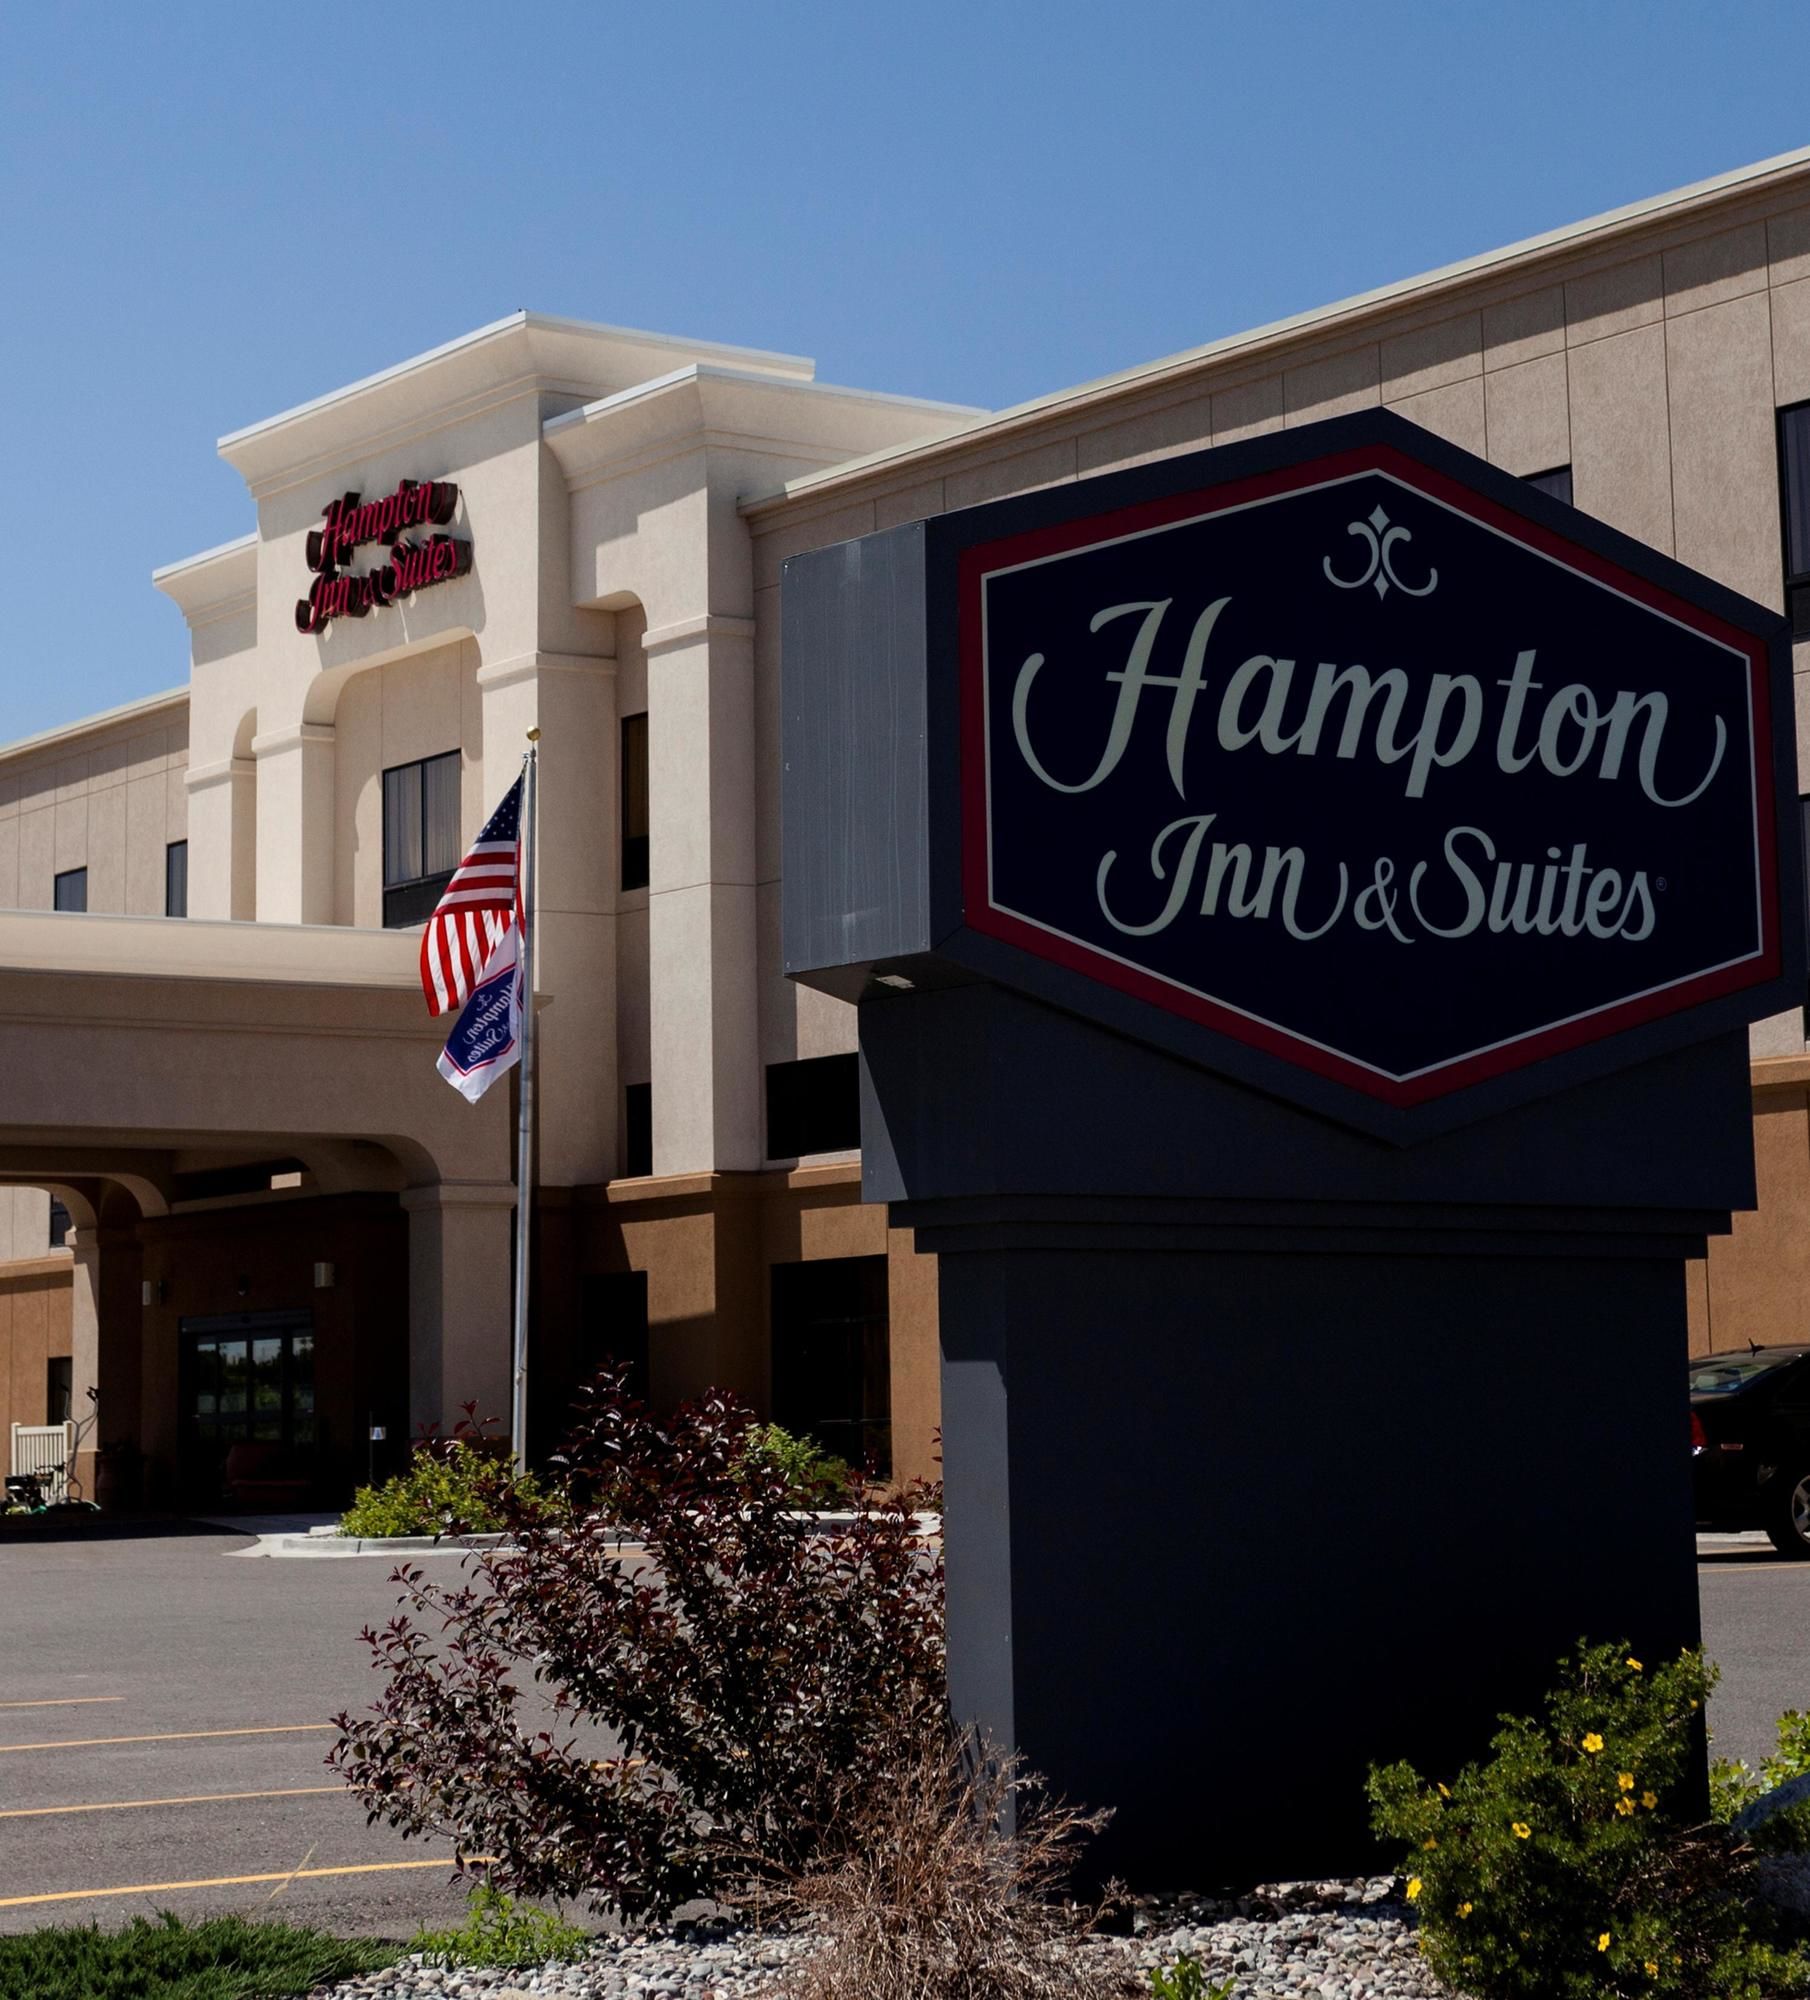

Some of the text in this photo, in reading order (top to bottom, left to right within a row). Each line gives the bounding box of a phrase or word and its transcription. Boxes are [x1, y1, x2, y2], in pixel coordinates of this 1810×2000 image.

[306, 479, 458, 572] Hampton
[295, 571, 368, 634] Inn
[379, 533, 472, 599] Suites
[1013, 597, 1726, 807] Hampton
[1097, 814, 1348, 940] Inn
[1354, 857, 1415, 943] &
